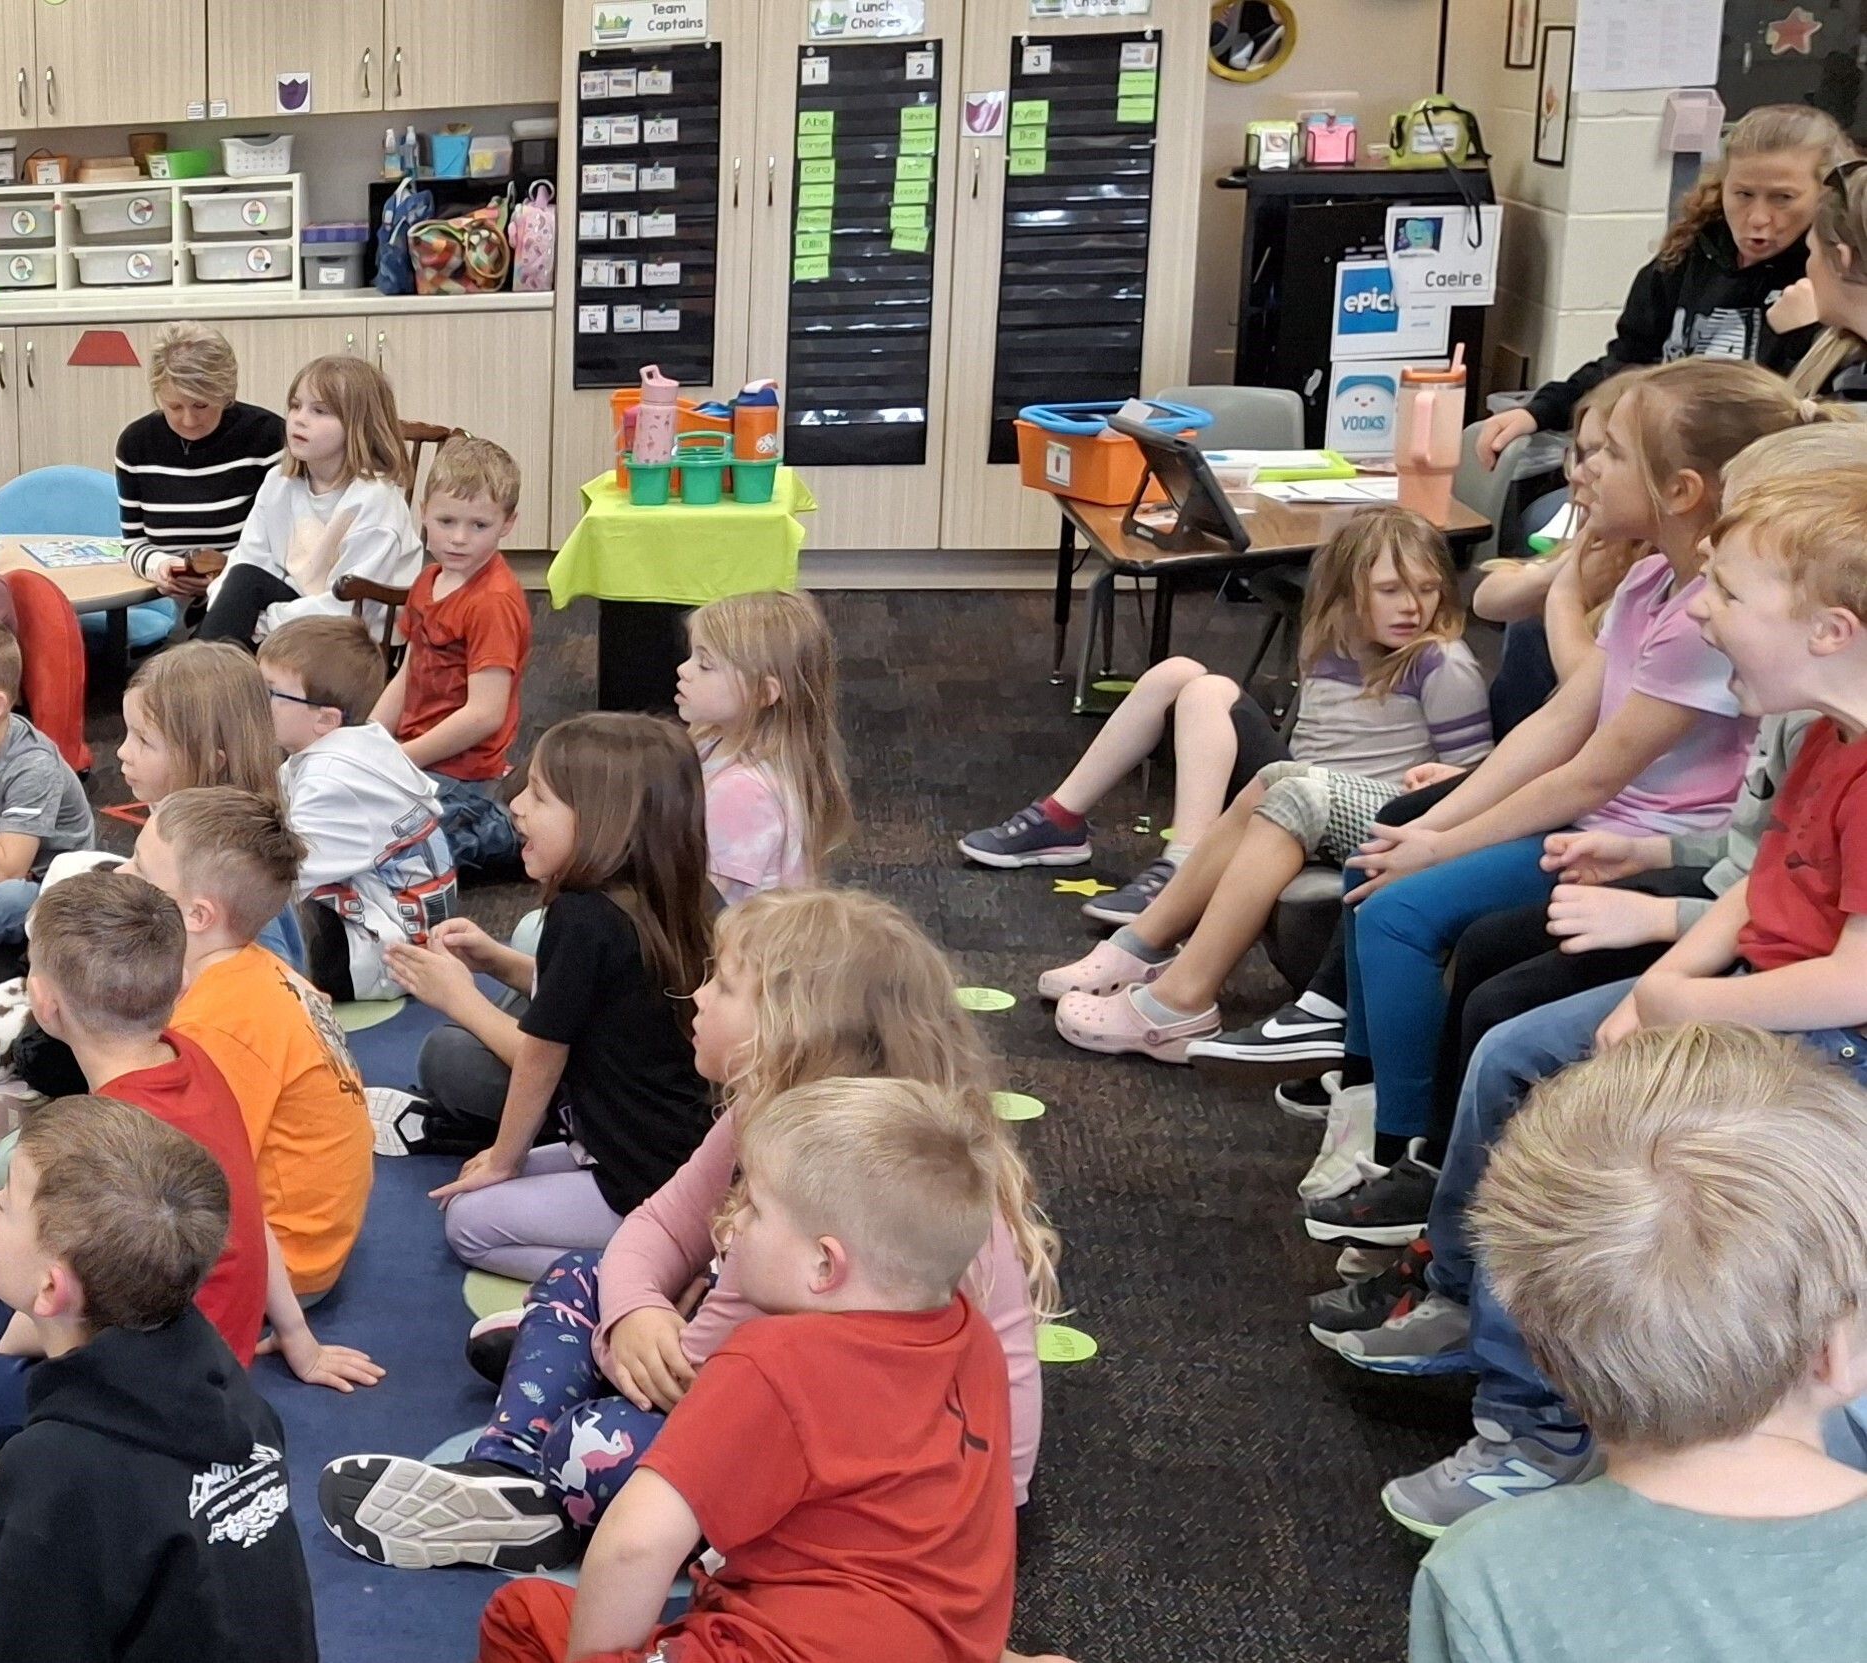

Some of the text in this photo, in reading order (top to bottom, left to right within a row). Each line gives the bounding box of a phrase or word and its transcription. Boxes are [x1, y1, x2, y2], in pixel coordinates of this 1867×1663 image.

[653, 4, 686, 15] Team
[856, 1, 894, 13] Lunch
[647, 19, 703, 32] Captains
[851, 18, 901, 30] Choices
[1033, 55, 1041, 67] 3
[916, 63, 924, 75] 2
